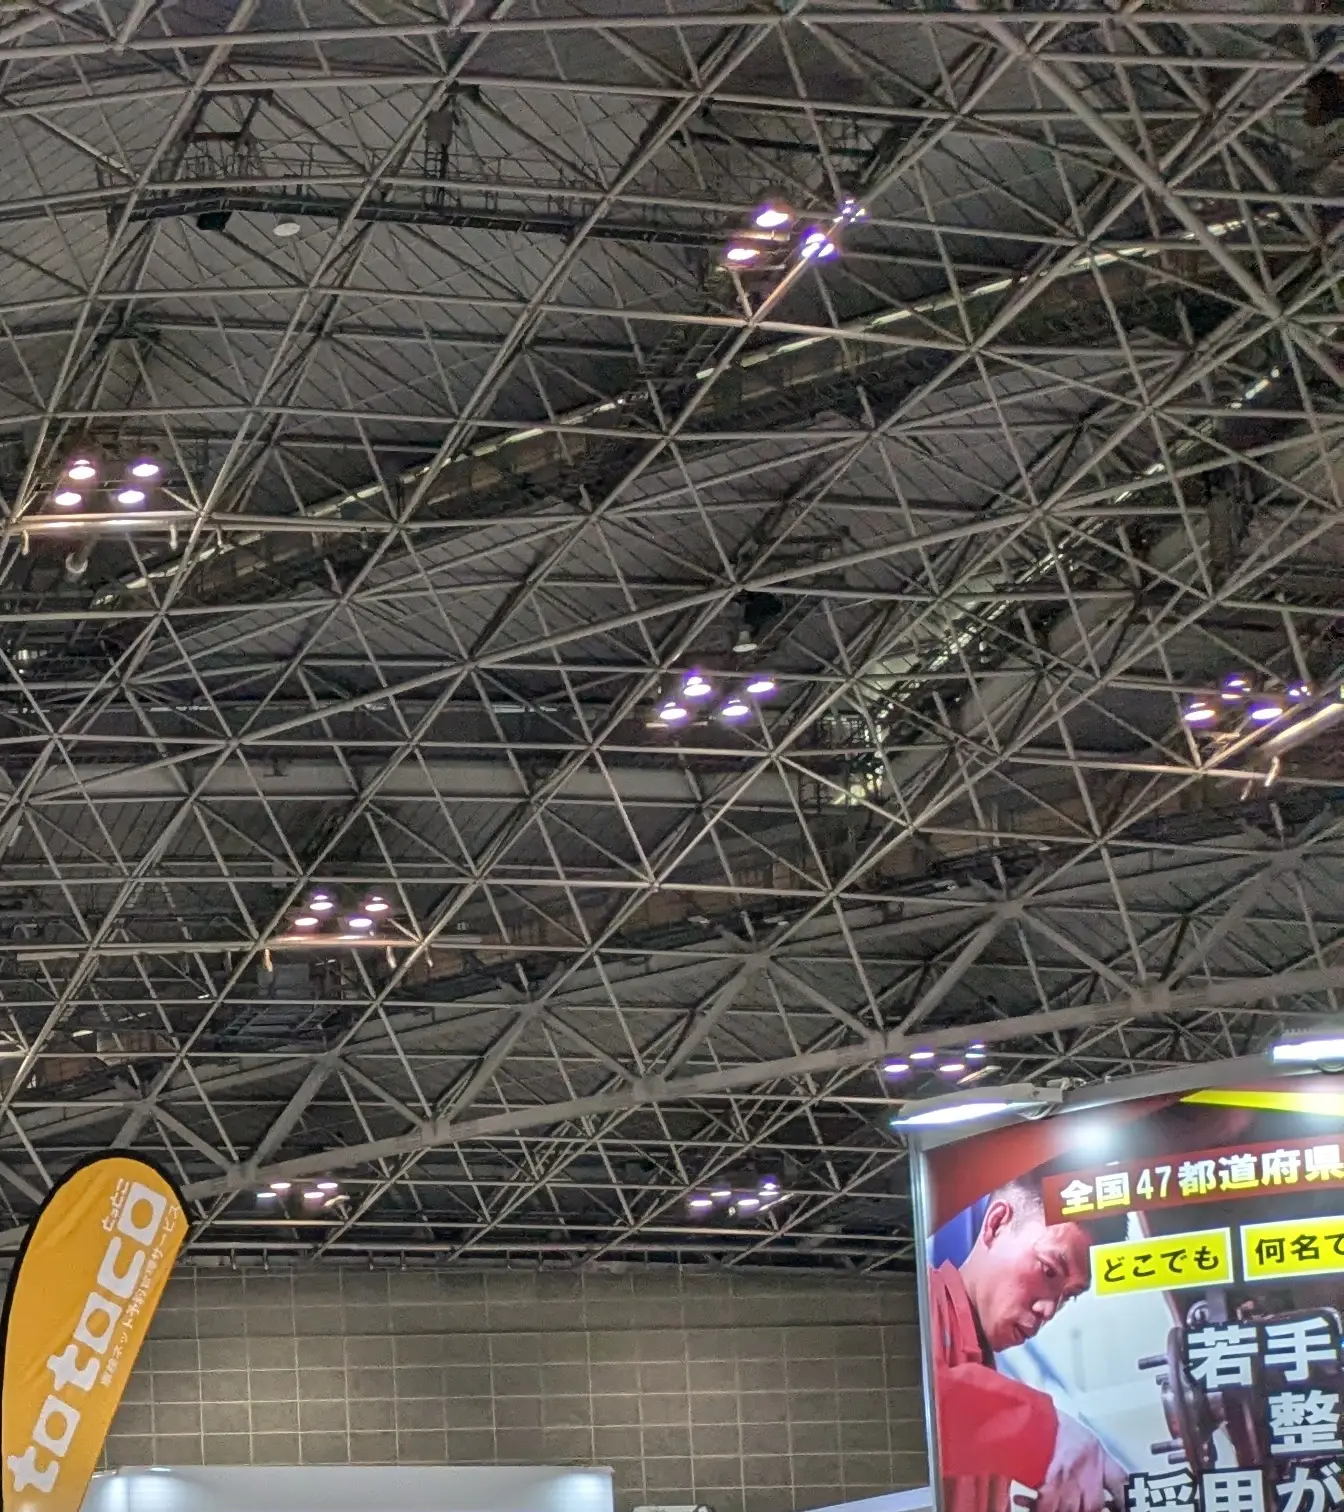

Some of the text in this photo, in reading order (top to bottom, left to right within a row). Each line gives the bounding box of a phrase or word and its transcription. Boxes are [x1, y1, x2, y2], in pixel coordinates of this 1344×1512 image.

[7, 1181, 168, 1494] totoco
[1102, 1245, 1220, 1284] どこでも
